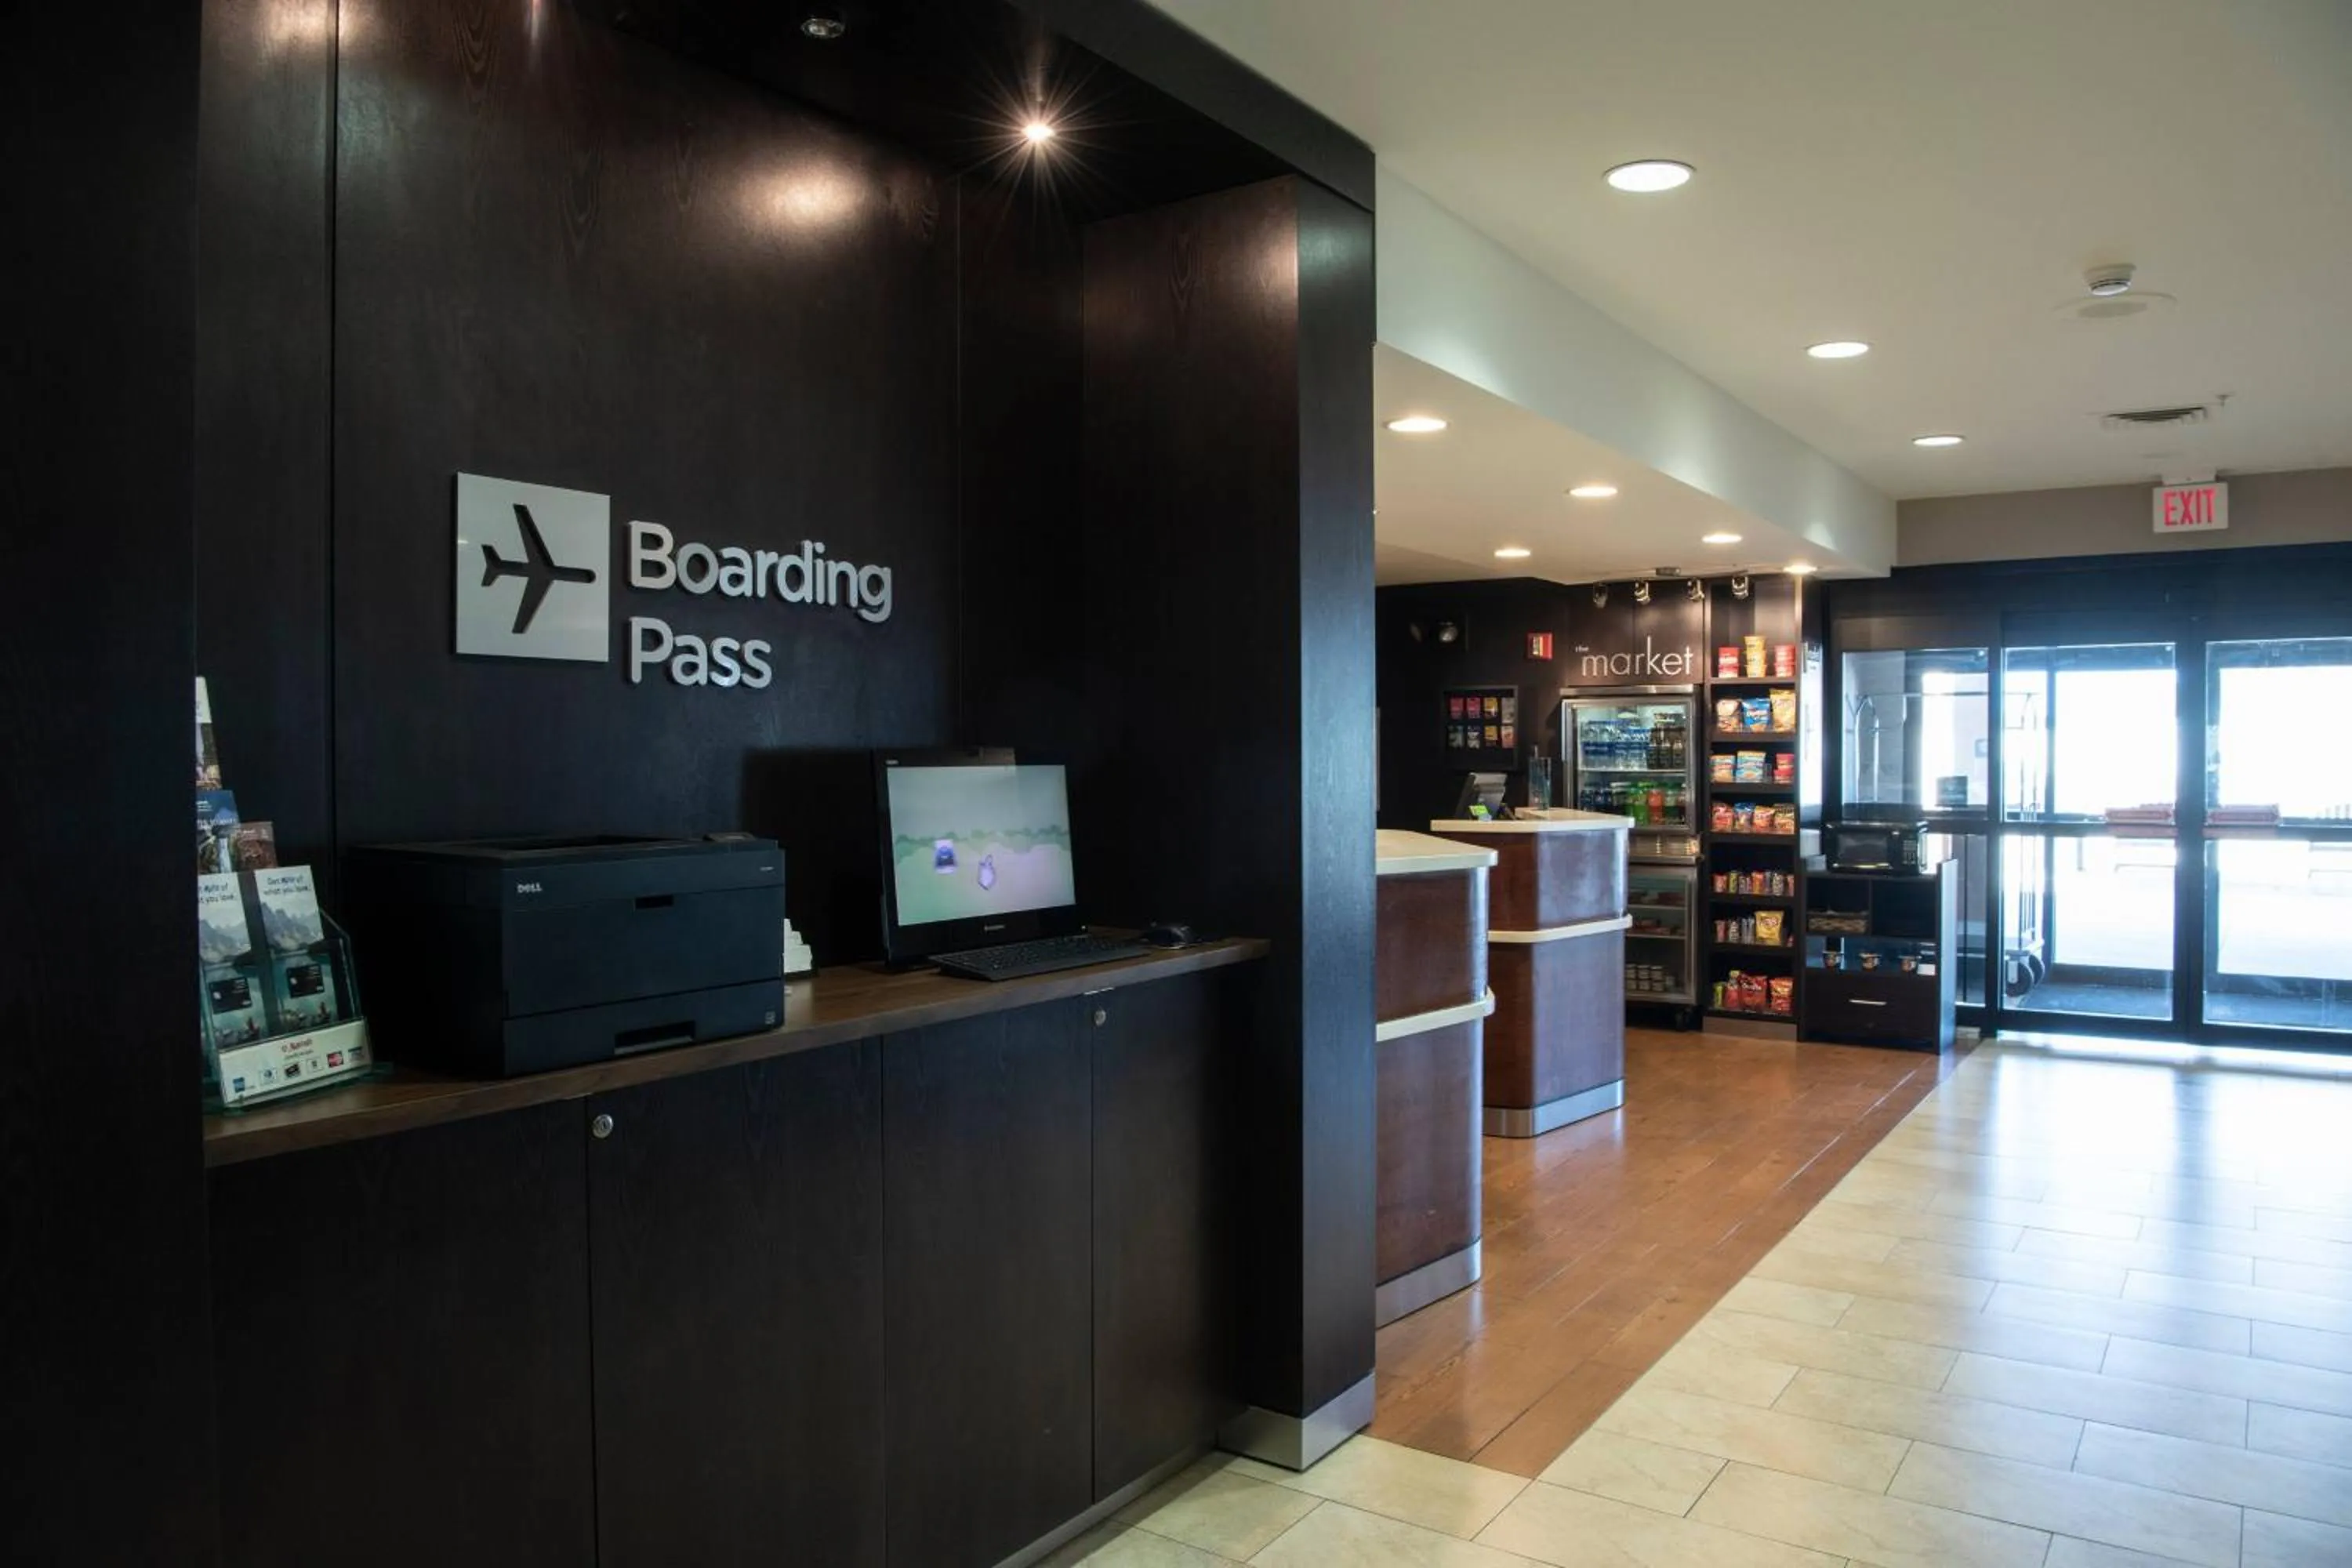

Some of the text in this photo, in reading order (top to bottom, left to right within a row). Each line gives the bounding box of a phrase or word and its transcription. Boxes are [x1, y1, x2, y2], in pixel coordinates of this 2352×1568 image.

[2164, 488, 2215, 526] EXIT
[628, 520, 892, 623] Boarding
[628, 616, 773, 689] Pass
[1581, 635, 1694, 677] market
[517, 883, 543, 894] DELL
